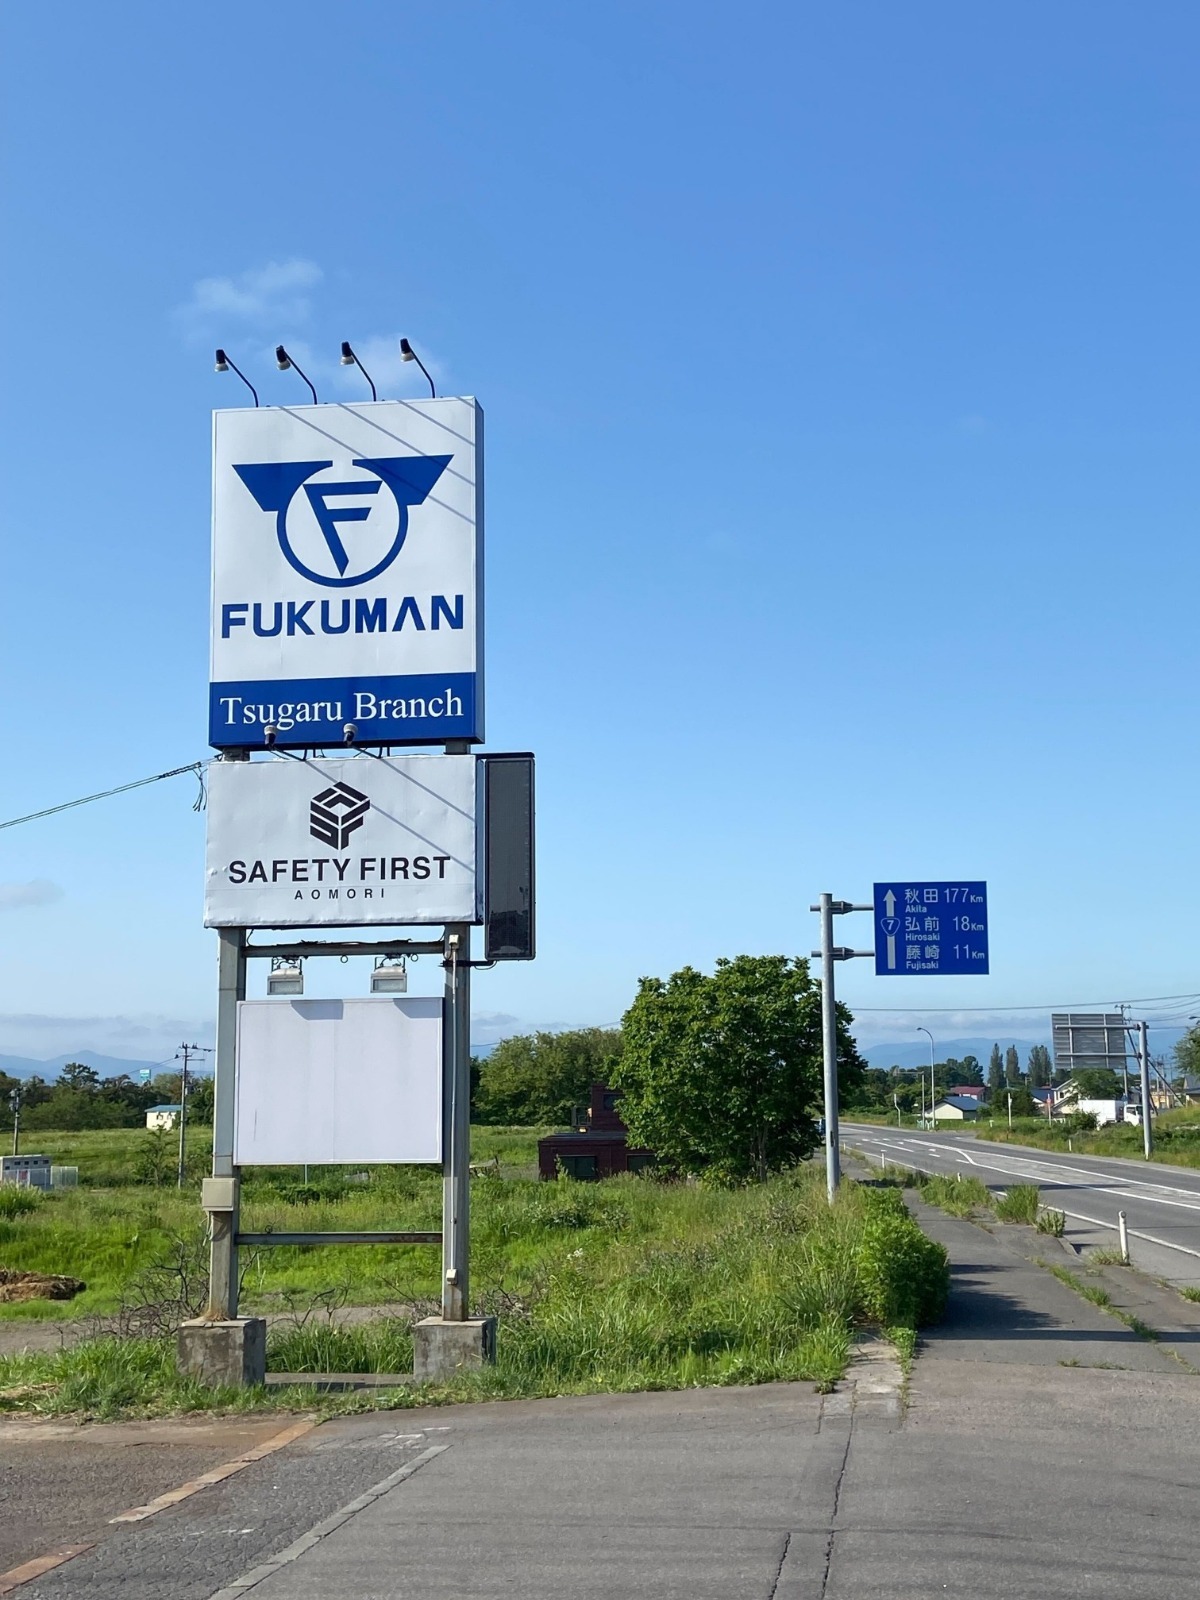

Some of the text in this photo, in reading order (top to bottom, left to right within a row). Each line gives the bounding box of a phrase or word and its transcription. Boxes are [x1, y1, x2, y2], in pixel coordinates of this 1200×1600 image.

[221, 594, 463, 638] FUKUMAN
[219, 688, 464, 730] Tsugaru Branch
[229, 855, 451, 884] SAFETY FIRST
[294, 888, 385, 900] AOMORI
[905, 905, 927, 913] Akita
[886, 919, 895, 931] 7
[905, 933, 940, 941] Hirosaki
[906, 961, 939, 970] Fujisaki
